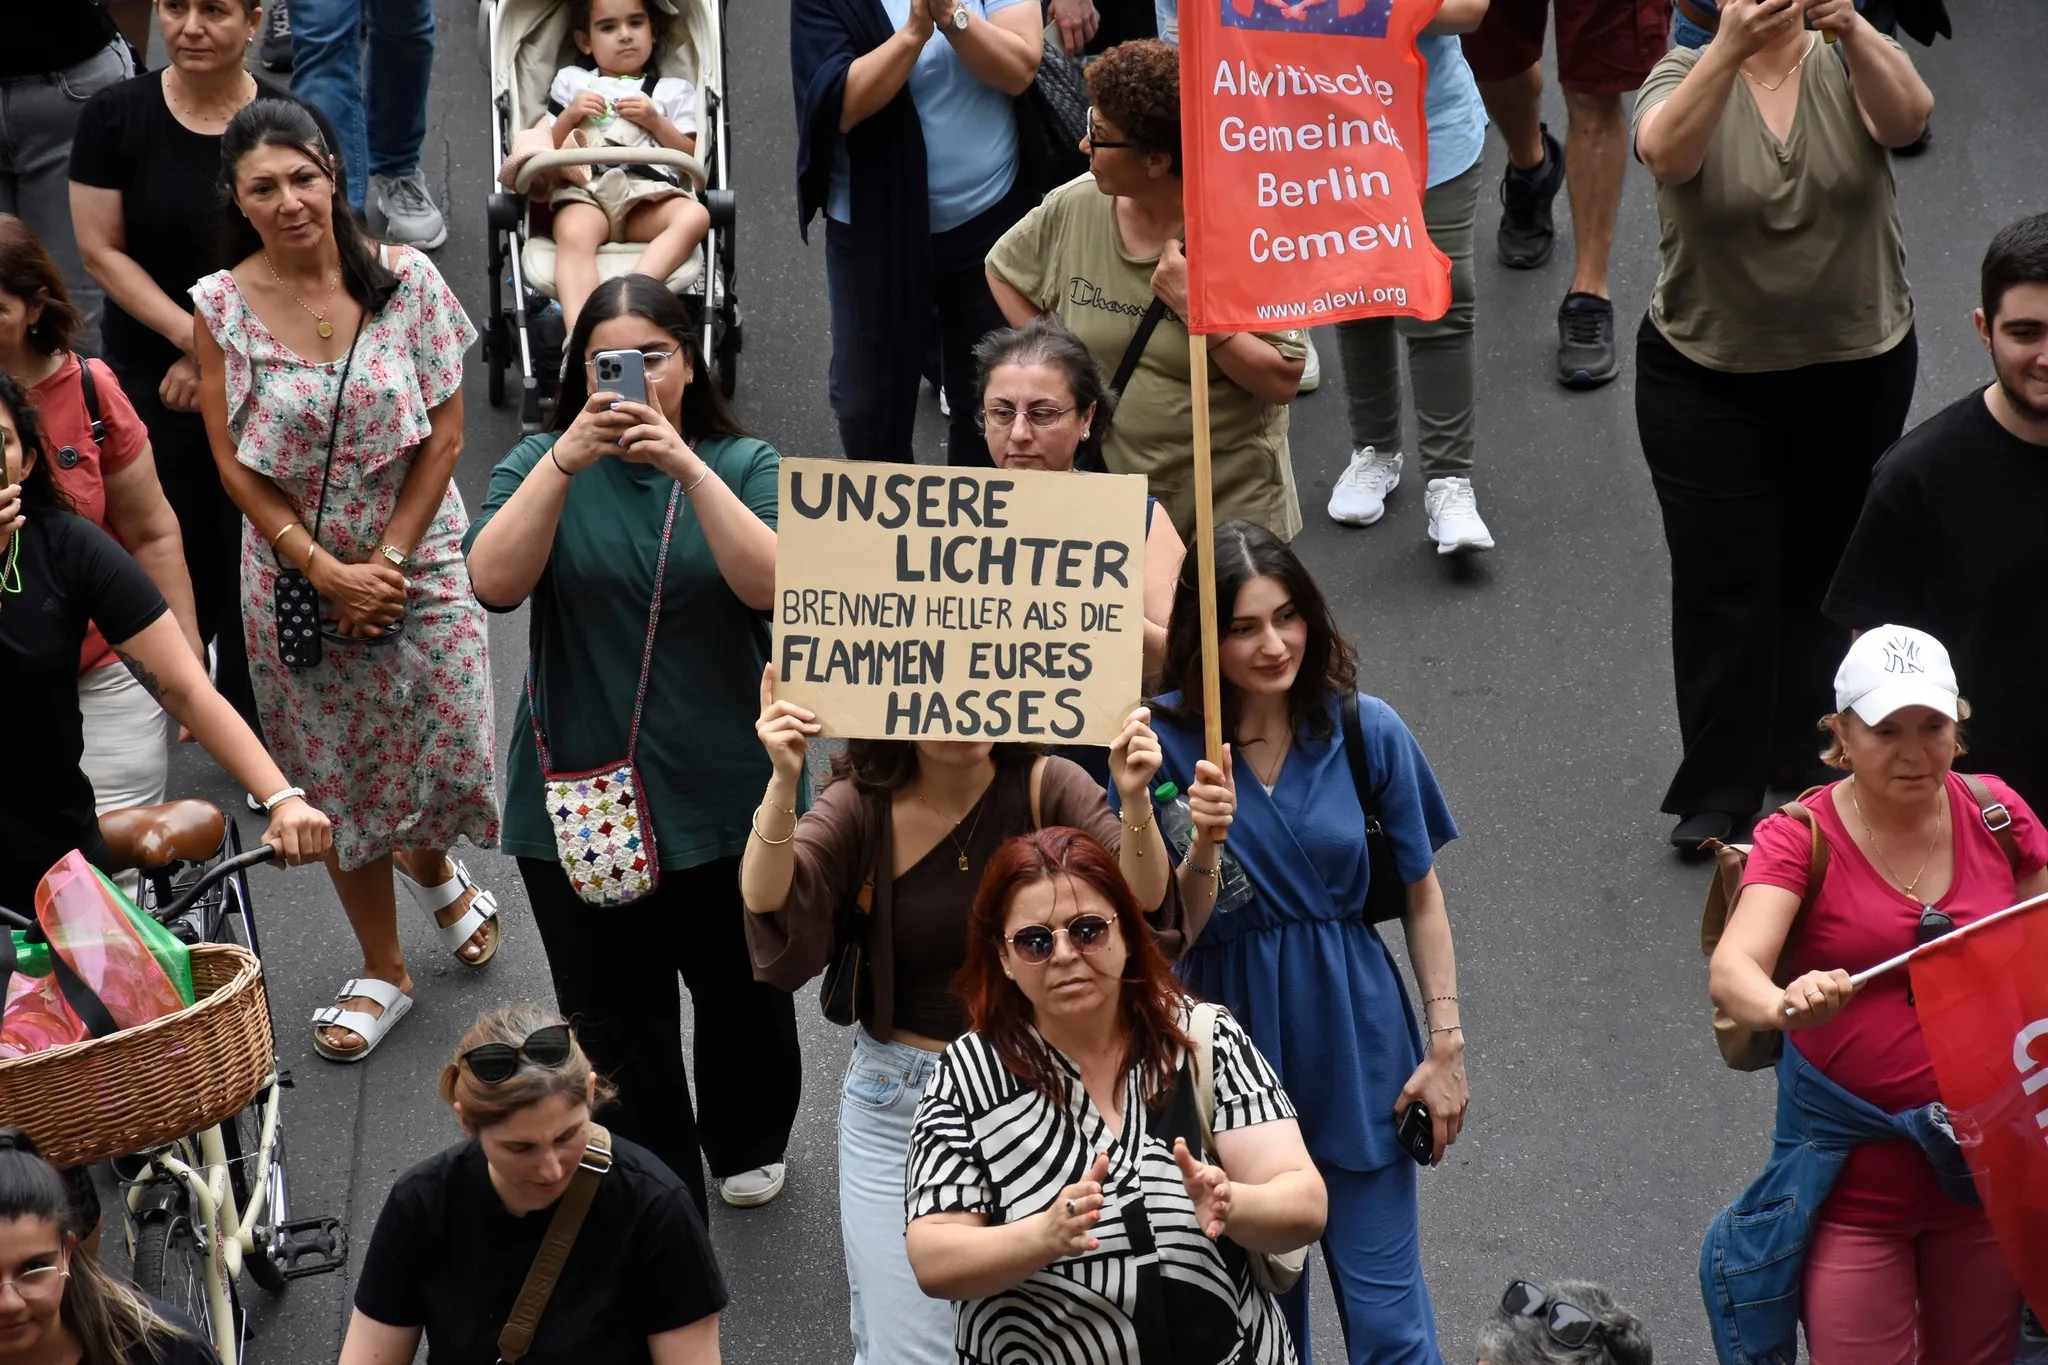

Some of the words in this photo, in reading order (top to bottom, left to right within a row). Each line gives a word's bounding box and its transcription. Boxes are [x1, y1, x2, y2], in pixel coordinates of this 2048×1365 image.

[1214, 60, 1392, 105] Alevitische
[1220, 114, 1403, 152] Gemeinde
[1258, 166, 1390, 207] Berlin
[1250, 216, 1412, 263] Cemevi
[1257, 286, 1406, 319] www.alevi.org
[791, 472, 1014, 529] UNSERE
[896, 535, 1129, 588] LICHTER
[784, 589, 915, 628] BRENNEN
[927, 597, 1012, 630] HELLER
[1024, 601, 1066, 630] ALS
[1081, 603, 1123, 632] DIE
[781, 635, 944, 686] FLAMMEN
[969, 642, 1092, 681] EURES
[885, 689, 1085, 739] HASSES
